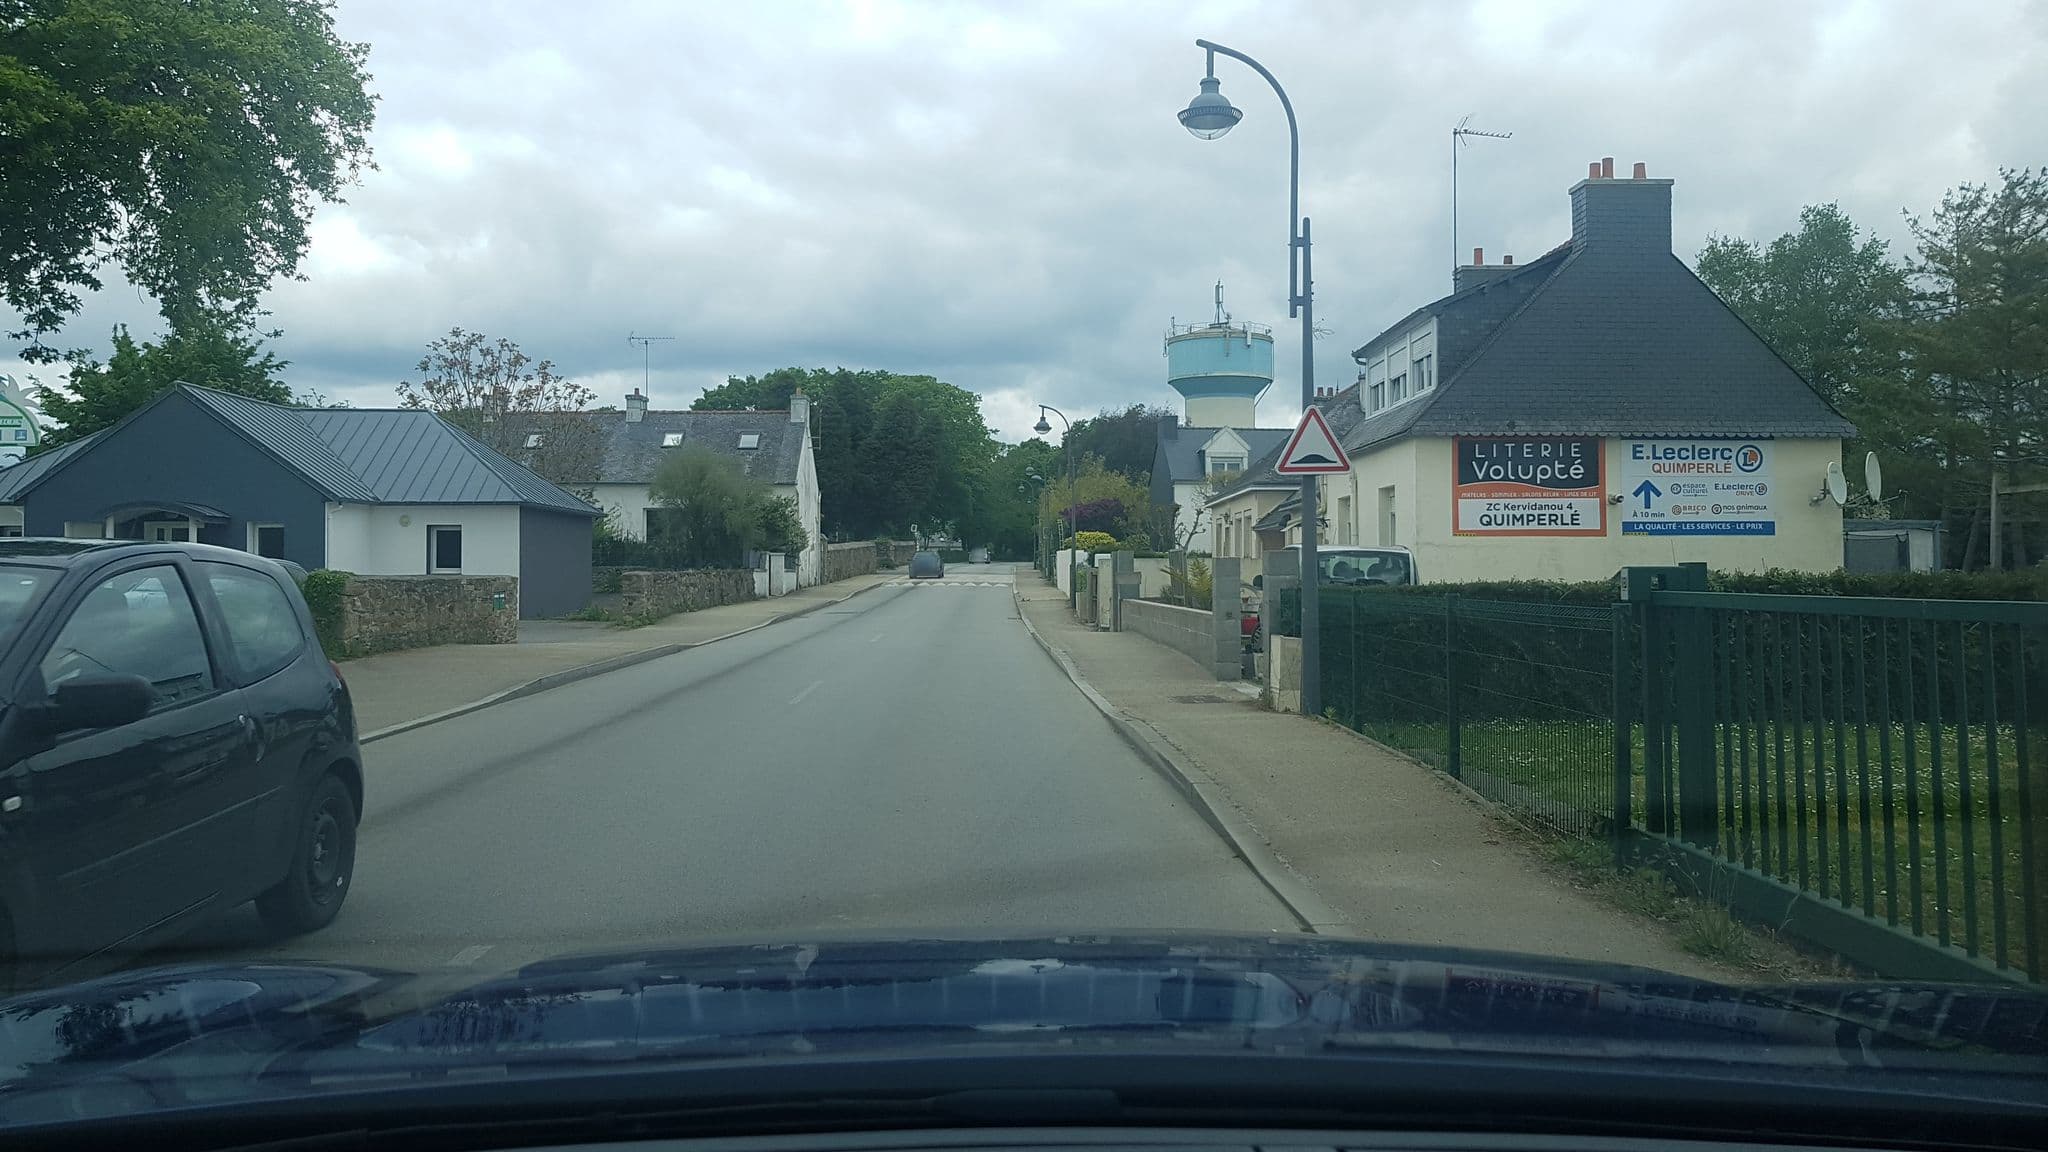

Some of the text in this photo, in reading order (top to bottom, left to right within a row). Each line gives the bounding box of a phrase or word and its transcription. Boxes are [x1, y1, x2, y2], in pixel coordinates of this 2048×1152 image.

[1475, 443, 1581, 458] LITERIE
[1632, 444, 1732, 460] E.Leclerc
[1472, 459, 1585, 483] Volupté
[1652, 460, 1732, 474] QUIMPERLÉ
[1486, 502, 1573, 512] ZC Kervidanou 4
[1632, 510, 1638, 518] À
[1480, 510, 1581, 526] QUIMPERLÉ
[1646, 522, 1676, 530] QUALITÉ
